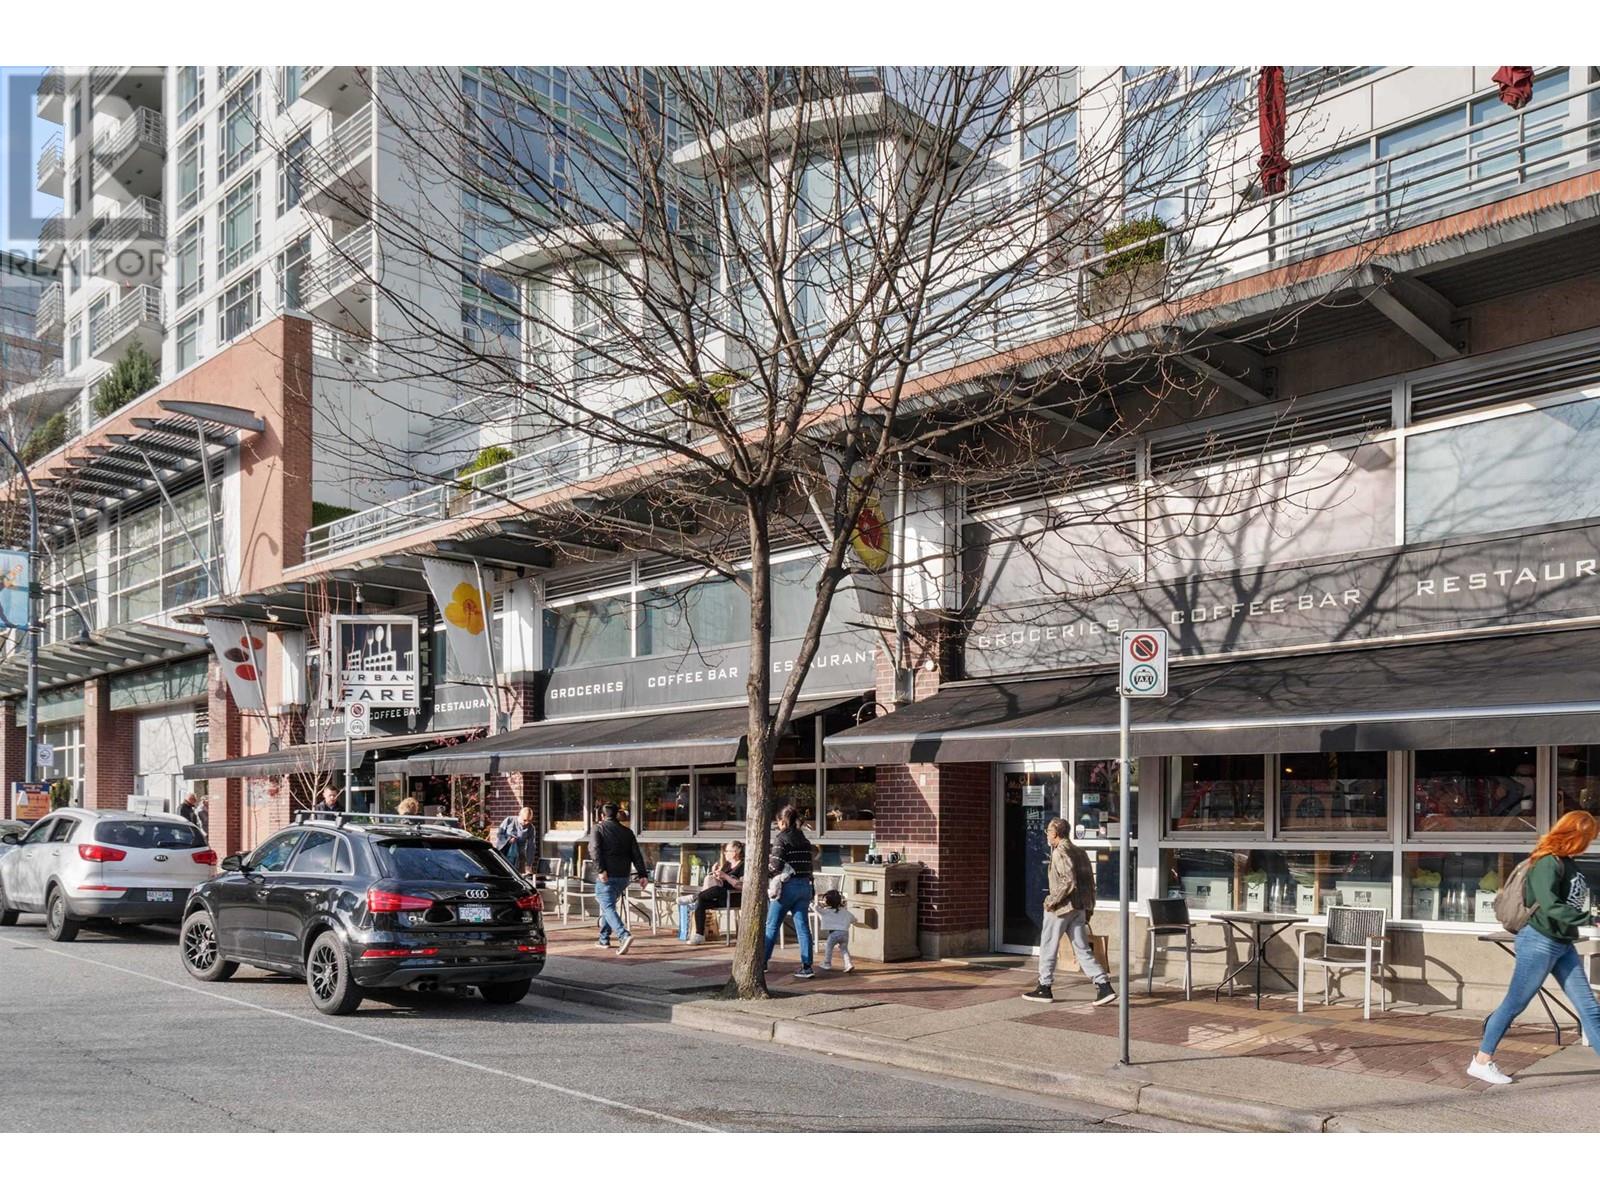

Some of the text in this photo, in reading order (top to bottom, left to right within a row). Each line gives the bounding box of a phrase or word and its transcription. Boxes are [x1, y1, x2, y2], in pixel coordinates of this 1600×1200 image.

[978, 618, 1120, 648] GROCERIES
[1170, 598, 1285, 625] COFFEE
[1298, 589, 1361, 610] BAR
[341, 674, 415, 682] URBAN
[550, 680, 624, 699] GROCERIES
[647, 670, 703, 688] COFFEE
[707, 667, 739, 681] BAR
[341, 689, 415, 701] FARE
[369, 709, 402, 721] COFFEE
[403, 707, 422, 717] BAR
